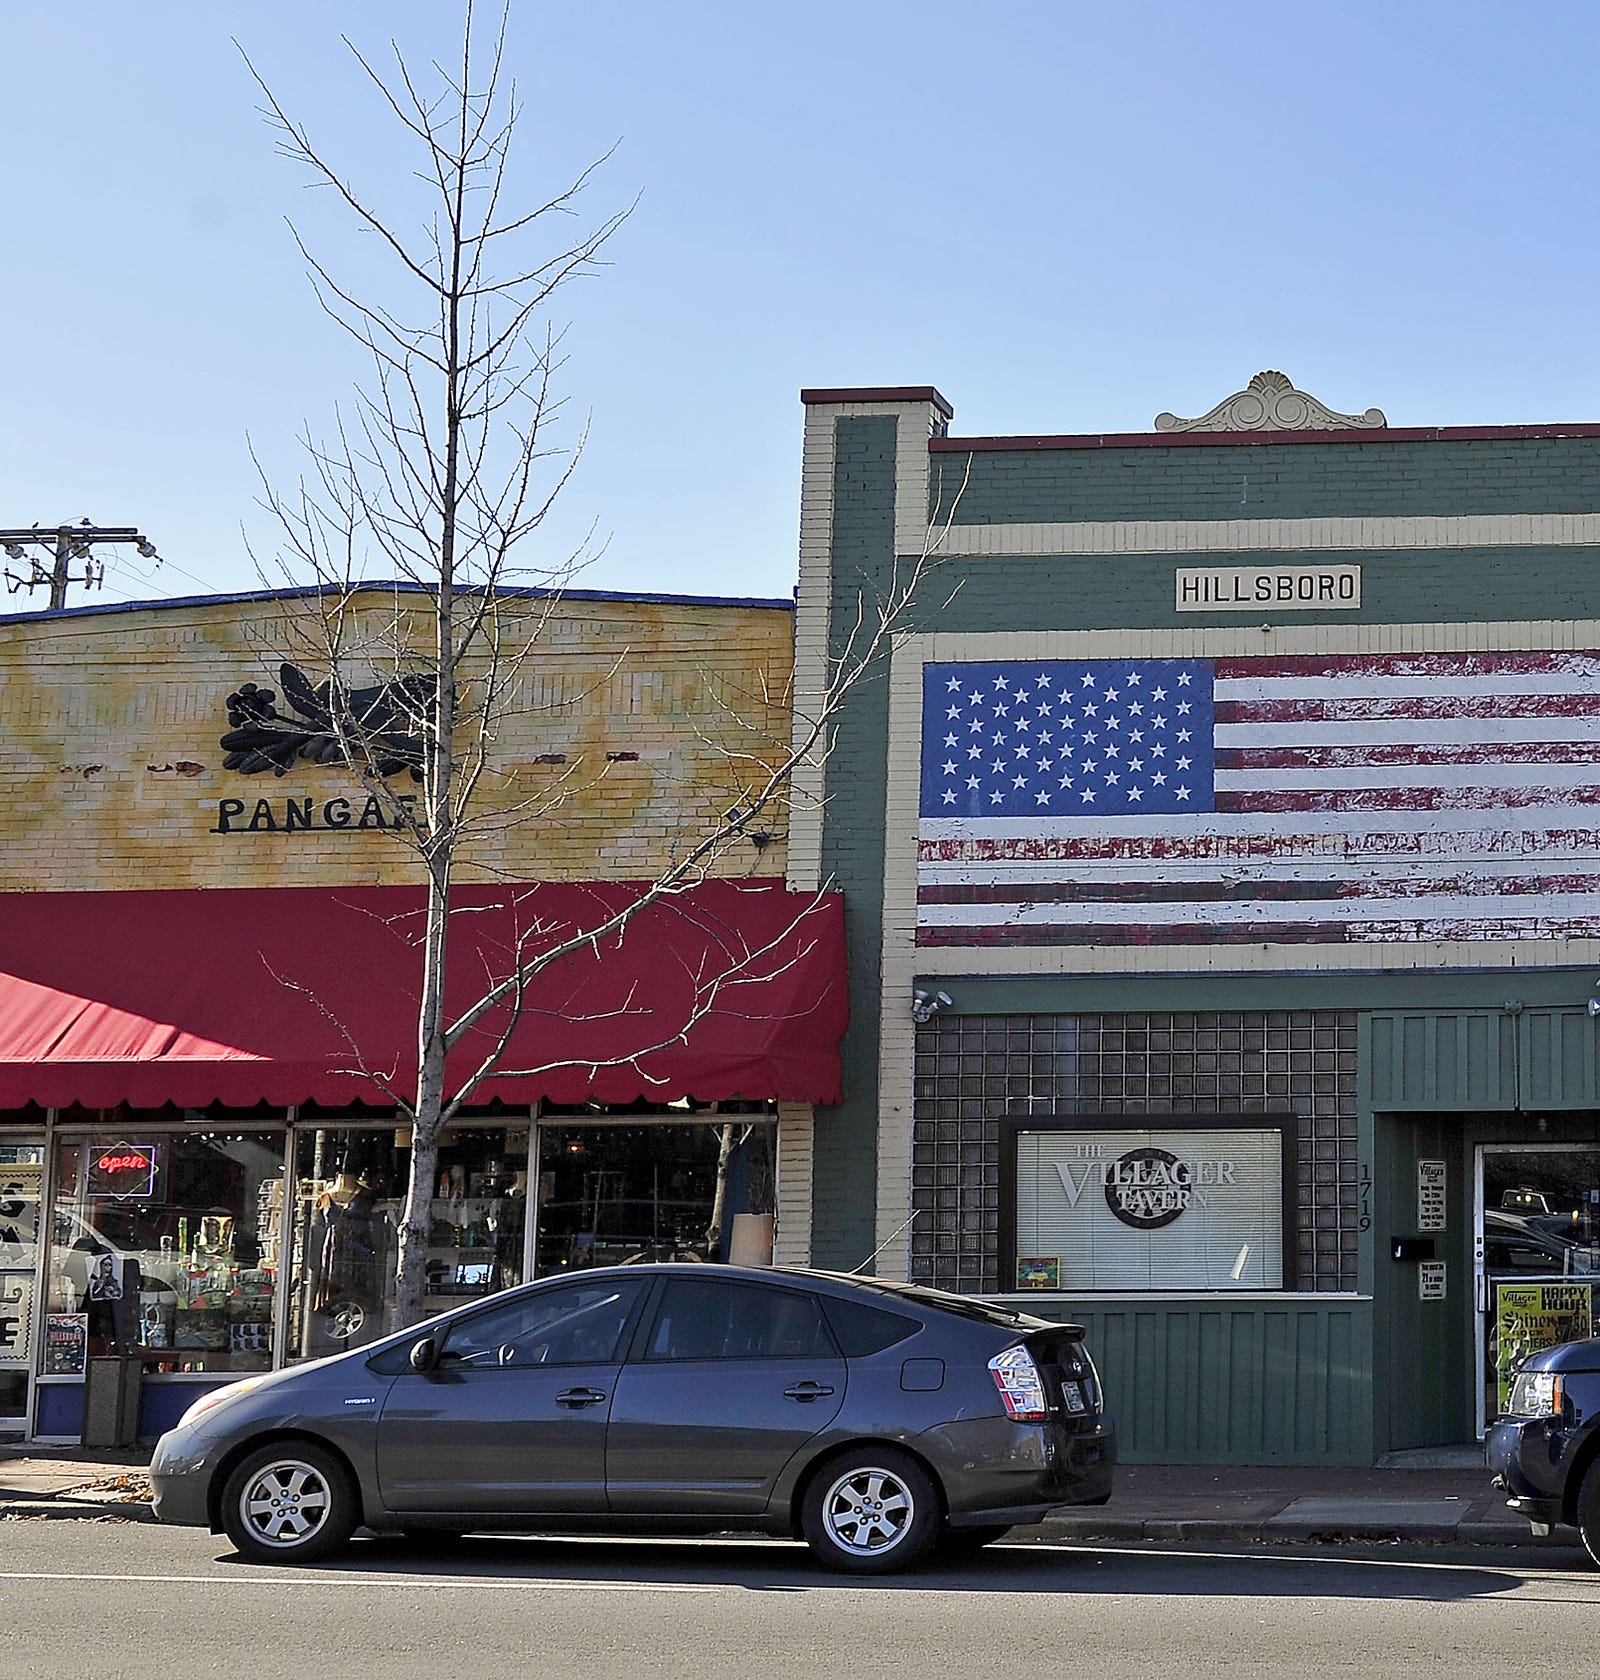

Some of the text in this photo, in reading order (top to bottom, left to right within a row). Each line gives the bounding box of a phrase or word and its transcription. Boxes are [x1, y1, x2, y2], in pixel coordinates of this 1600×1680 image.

[1182, 574, 1354, 602] HILLSBORO
[219, 794, 434, 833] PANGAE
[1075, 1144, 1106, 1158] THE
[98, 1155, 147, 1174] open
[1055, 1160, 1237, 1208] VILLAGER
[1115, 1190, 1208, 1211] TAVERN
[1359, 1164, 1372, 1233] 1719
[1541, 1287, 1587, 1300] HAPPY
[1541, 1299, 1588, 1311] HOUR
